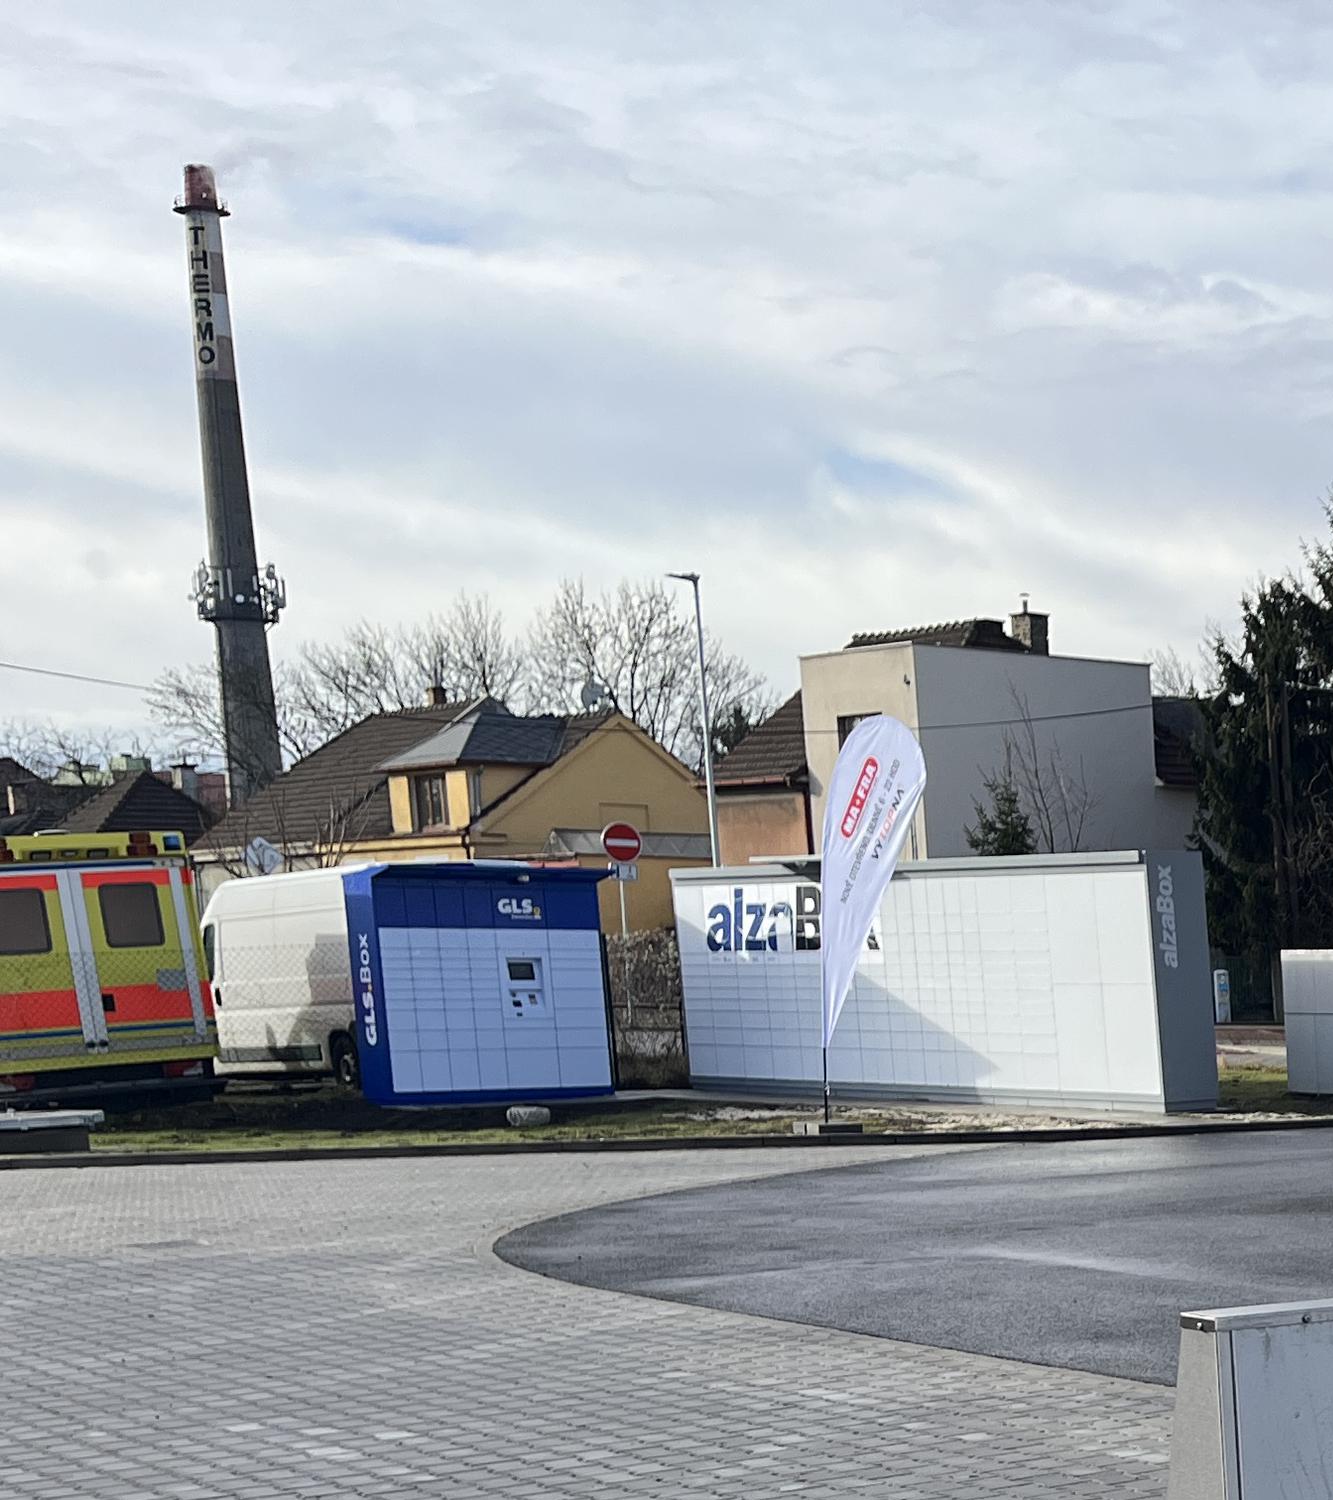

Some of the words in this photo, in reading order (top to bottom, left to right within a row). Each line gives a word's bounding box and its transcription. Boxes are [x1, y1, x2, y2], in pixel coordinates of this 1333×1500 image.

[189, 226, 215, 365] THERMO
[497, 898, 533, 914] GLS
[1156, 864, 1178, 969] alzaBox
